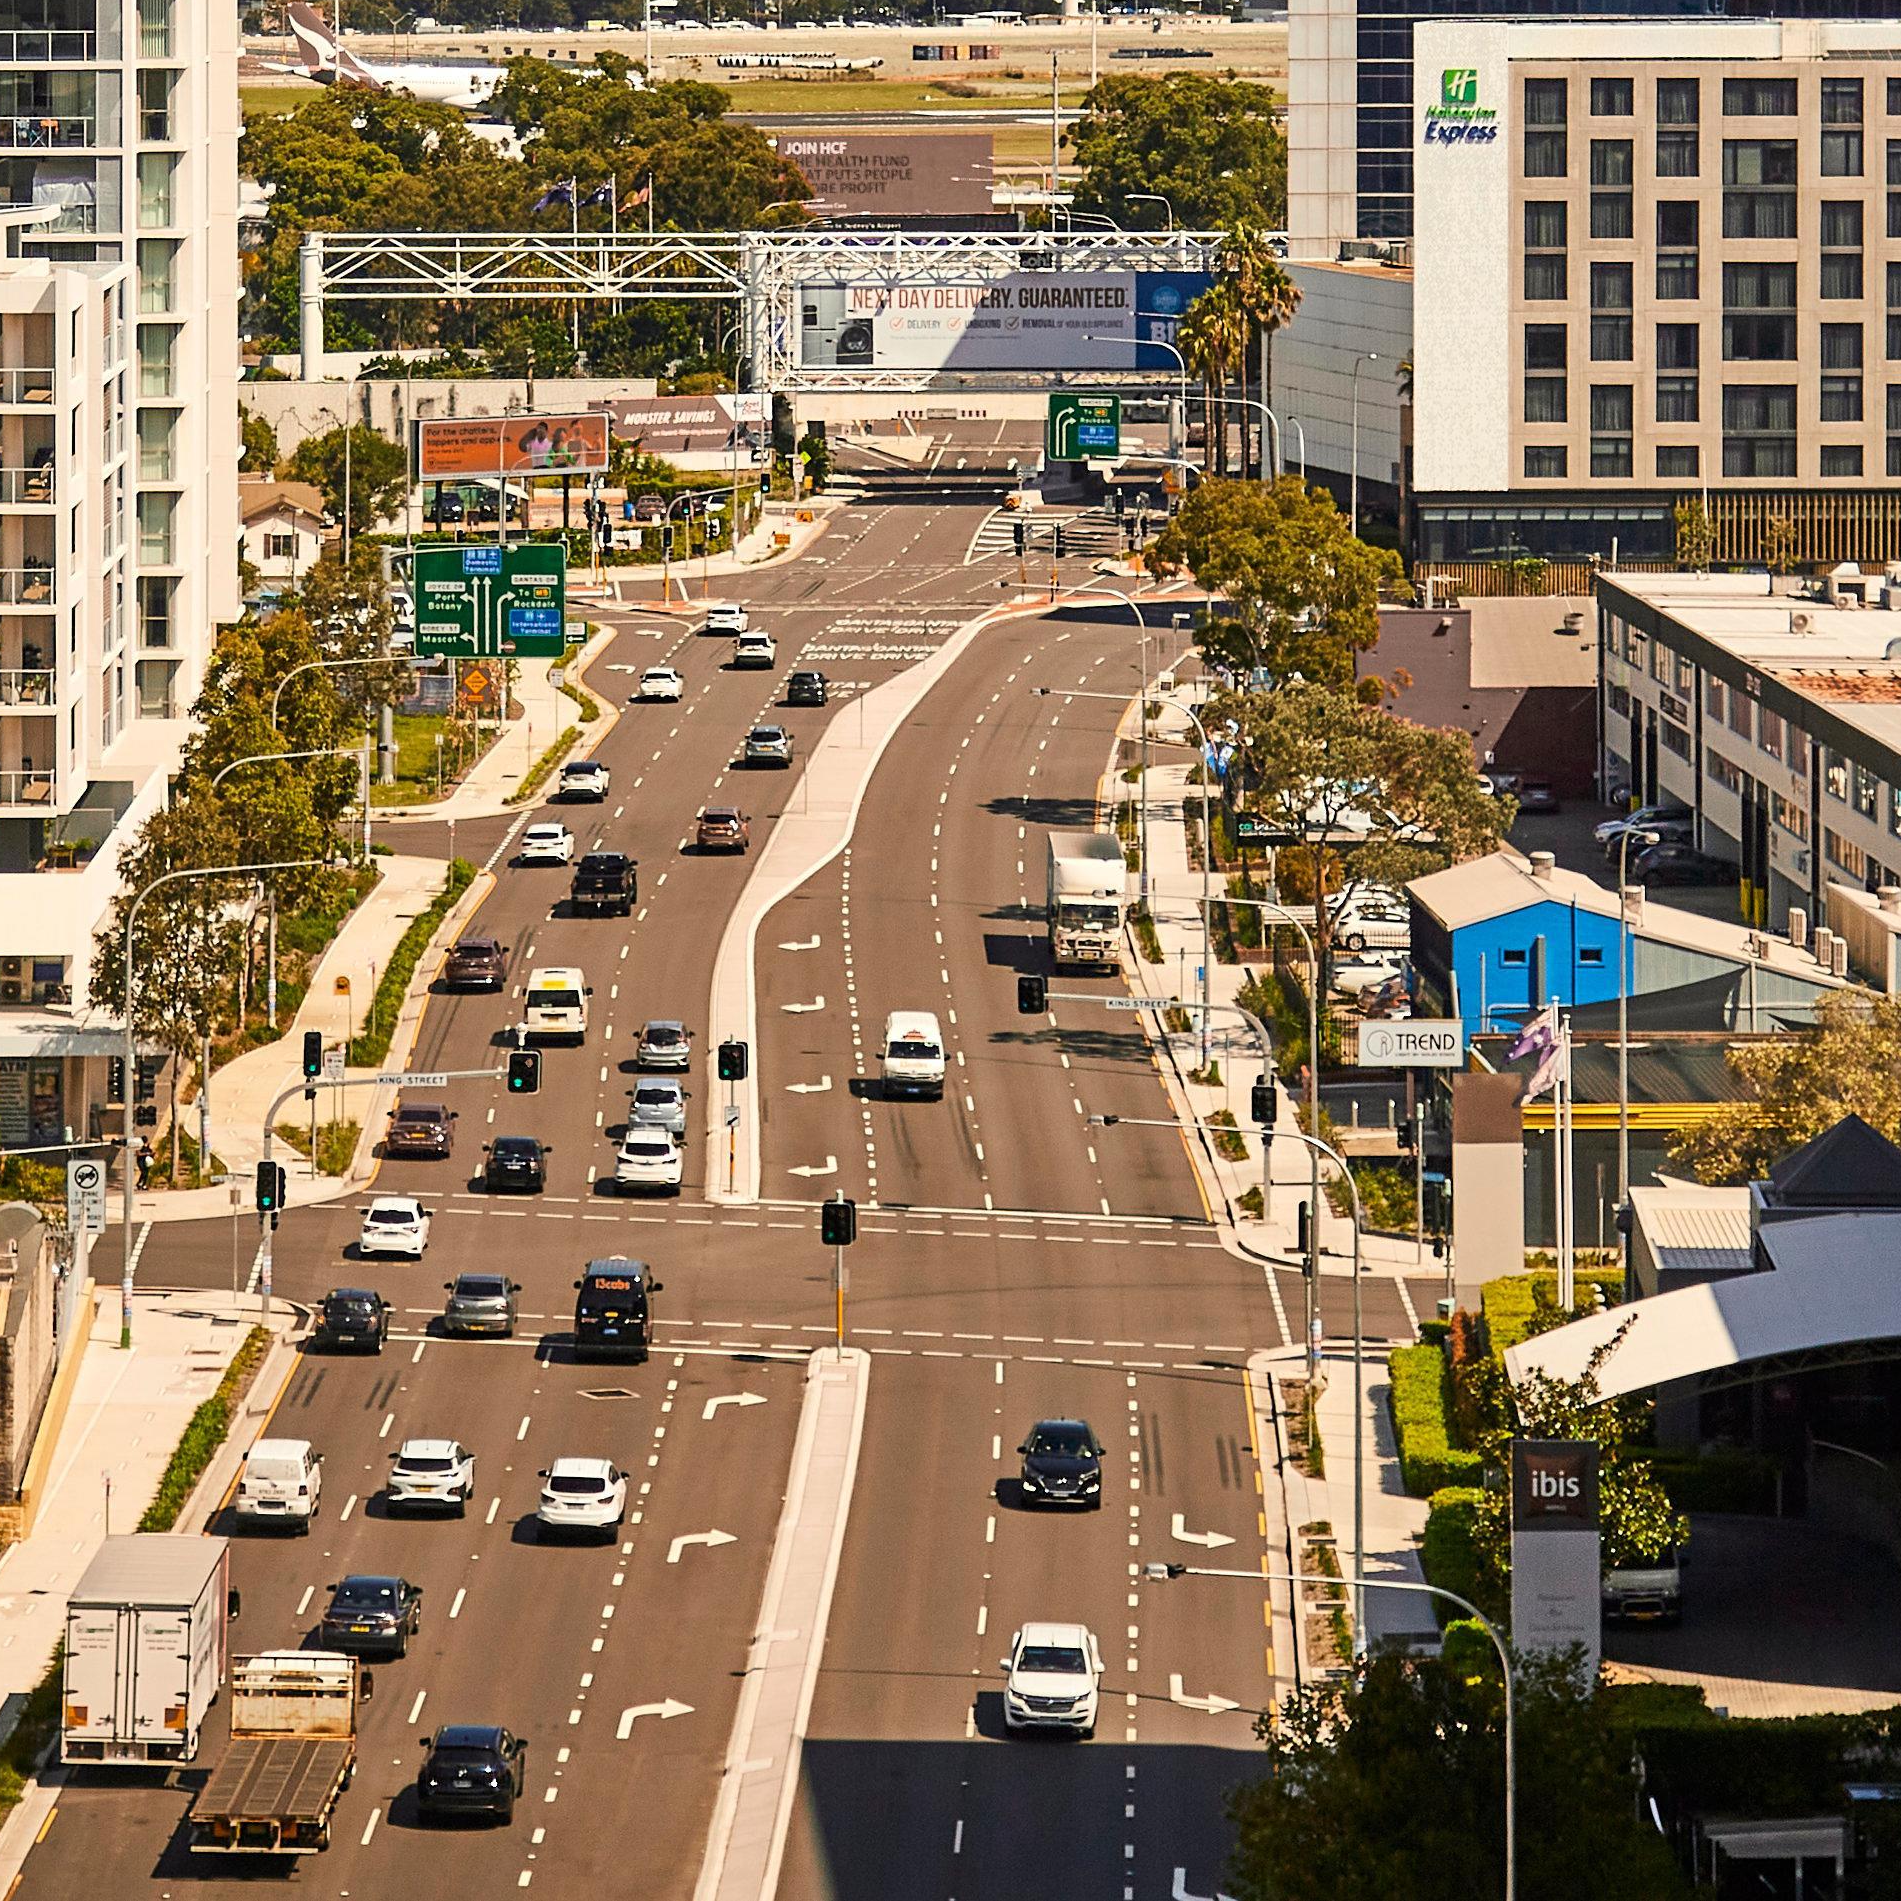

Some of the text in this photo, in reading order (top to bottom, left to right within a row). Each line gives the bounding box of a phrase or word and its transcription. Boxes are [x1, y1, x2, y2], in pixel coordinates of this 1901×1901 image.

[1426, 106, 1497, 121] Holiday Inn
[1424, 121, 1498, 144] Express
[784, 141, 848, 155] JOIN HCF
[795, 155, 910, 167] HE HEALTH FUND
[804, 168, 913, 180] AT PUTS PEOPLE
[840, 182, 888, 193] PROFIT
[845, 222, 876, 231] Sydney's
[876, 222, 902, 231] Airport
[853, 288, 892, 309] NEXT
[898, 289, 935, 309] DAY
[934, 288, 1015, 309] DELIVERY.
[906, 318, 941, 329] DELIVERY
[1022, 318, 1056, 329] REMOVAL
[623, 409, 717, 426] MONSTER SAVINGS
[426, 428, 441, 437] For
[443, 427, 457, 436] the
[434, 593, 456, 601] Port
[518, 588, 530, 596] To
[427, 601, 462, 611] Botany
[513, 600, 556, 608] Rockdale
[422, 635, 457, 643] Mascot
[805, 652, 866, 660] DRIVE
[870, 652, 930, 660] DRIVE
[1133, 1000, 1168, 1008] STREET
[1395, 1033, 1455, 1050] TREND
[379, 1076, 444, 1085] KING STREET
[595, 1277, 630, 1290] 13cabs
[1531, 1470, 1580, 1497] ibis
